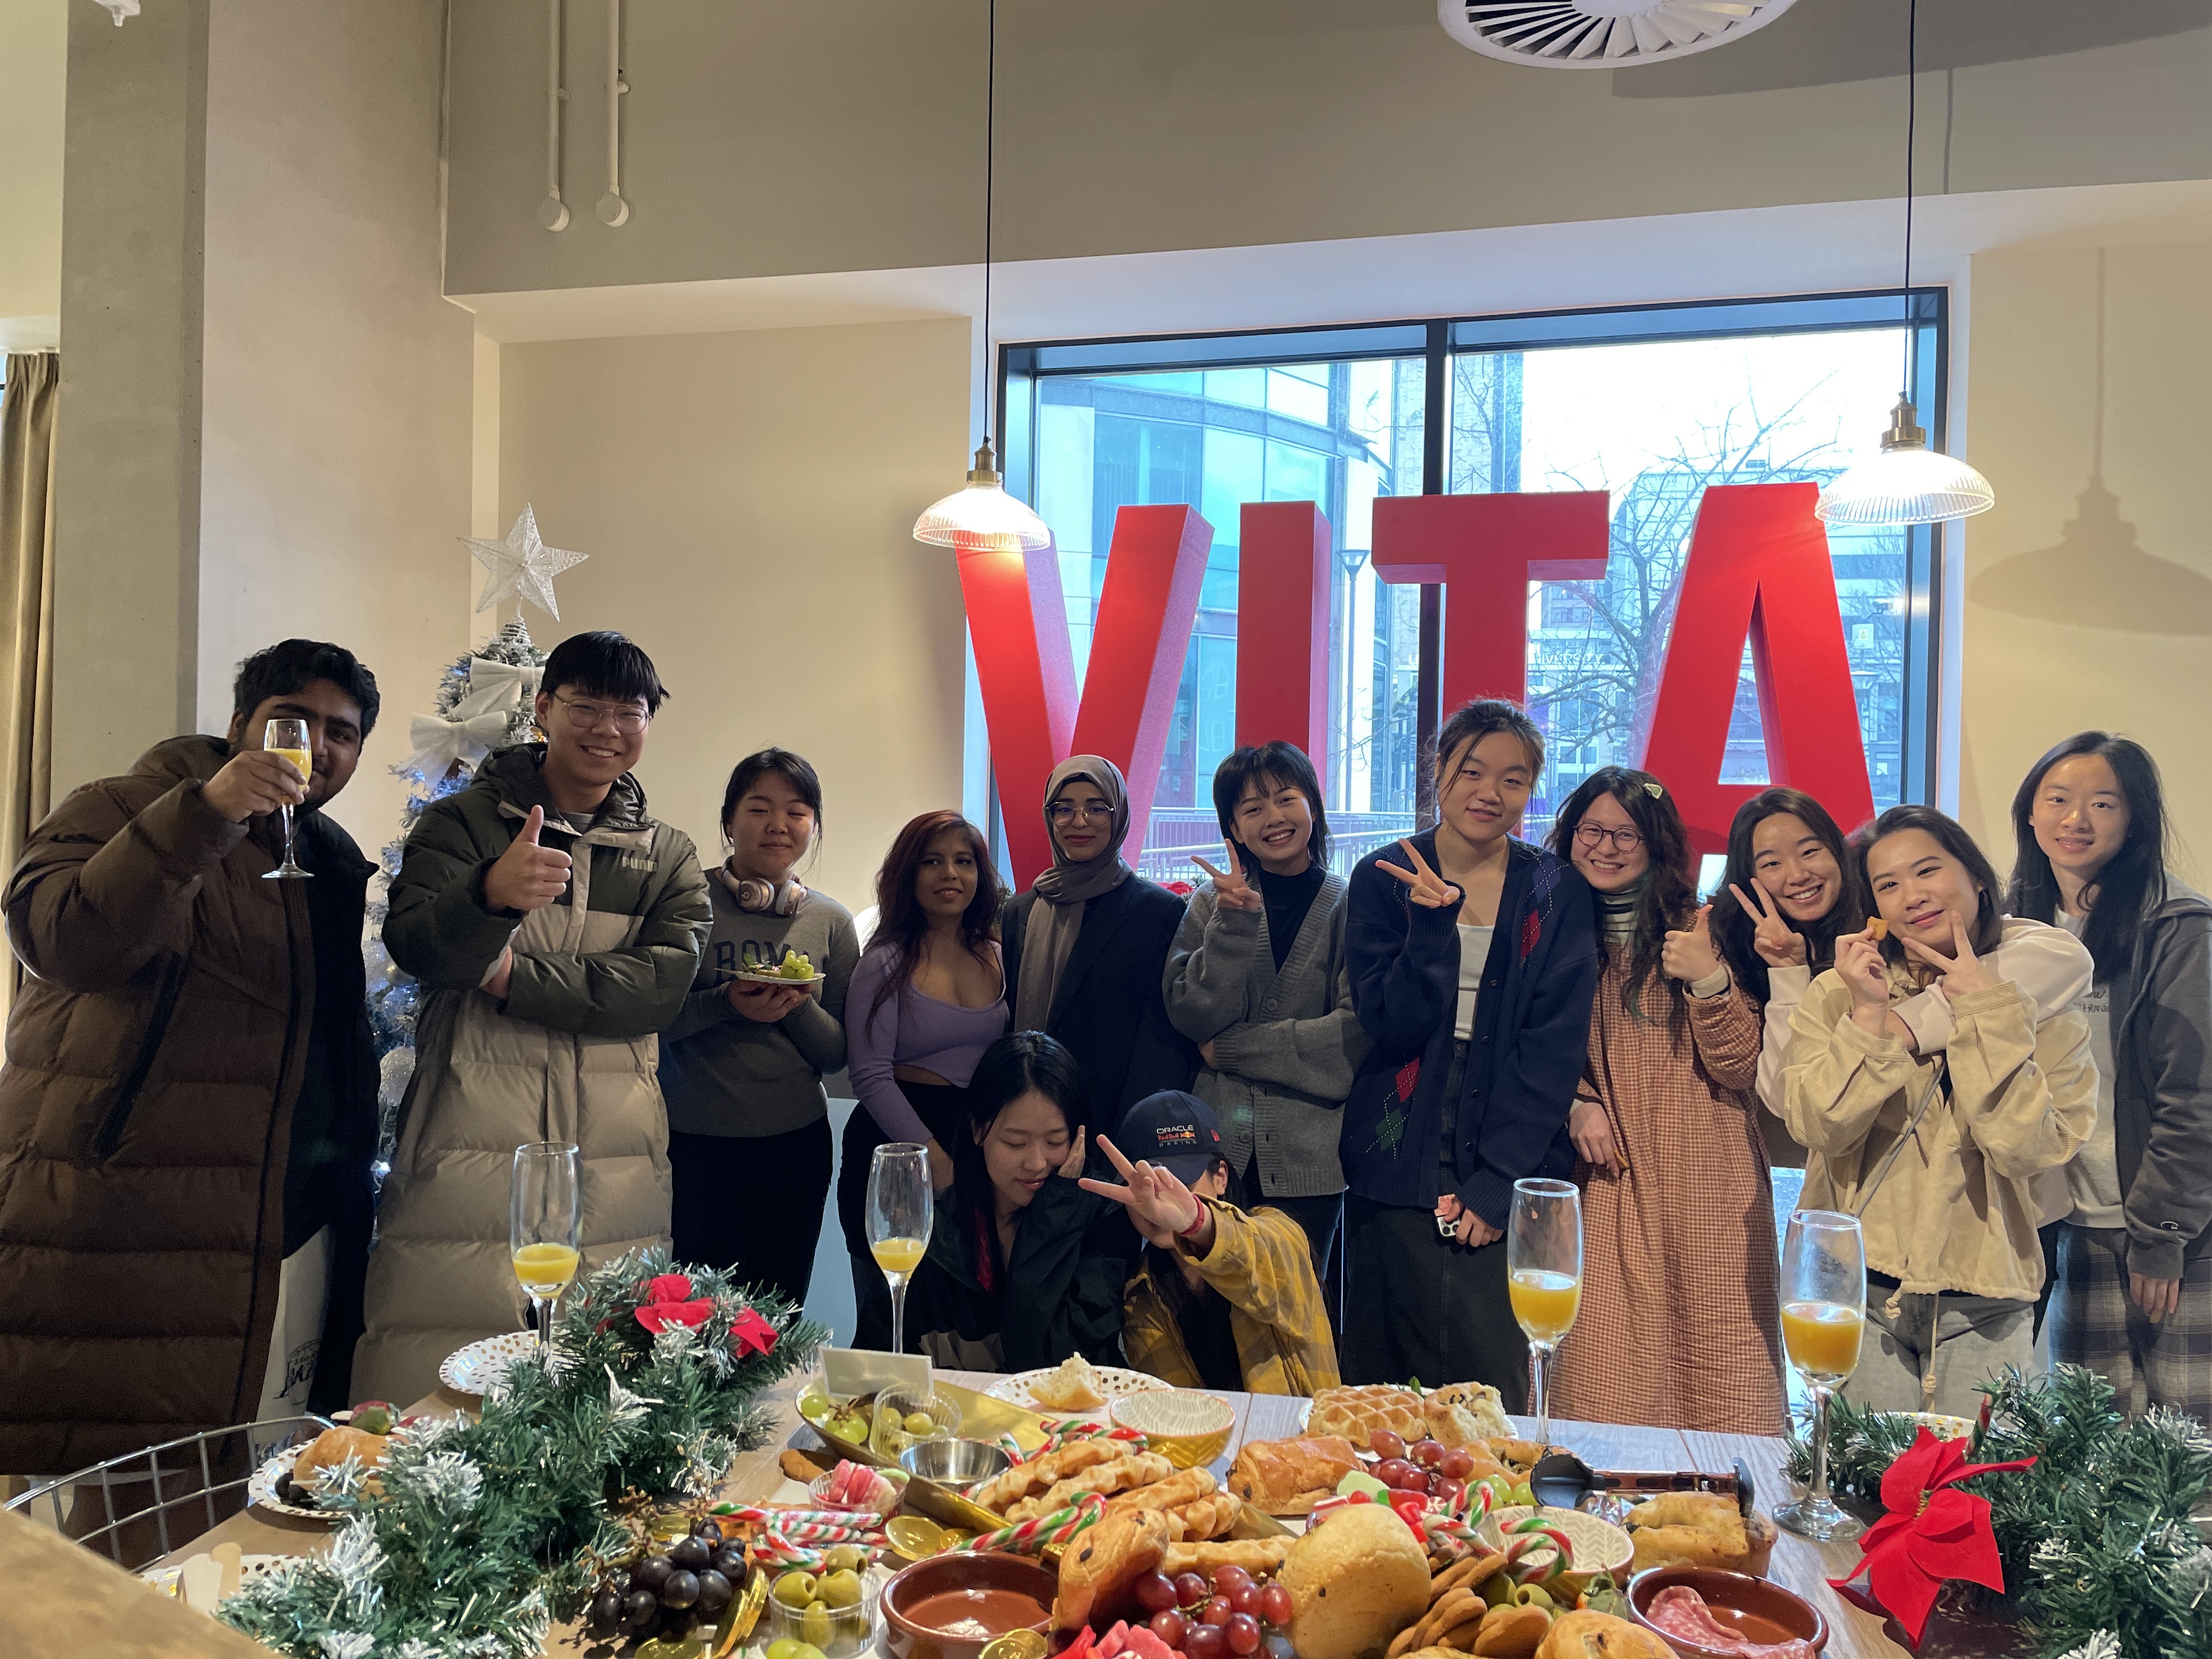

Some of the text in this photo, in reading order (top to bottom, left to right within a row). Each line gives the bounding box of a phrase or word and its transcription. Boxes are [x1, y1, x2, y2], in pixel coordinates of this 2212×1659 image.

[956, 482, 1875, 893] VITA
[714, 939, 811, 984] ROM
[1156, 1125, 1194, 1134] ORACLE
